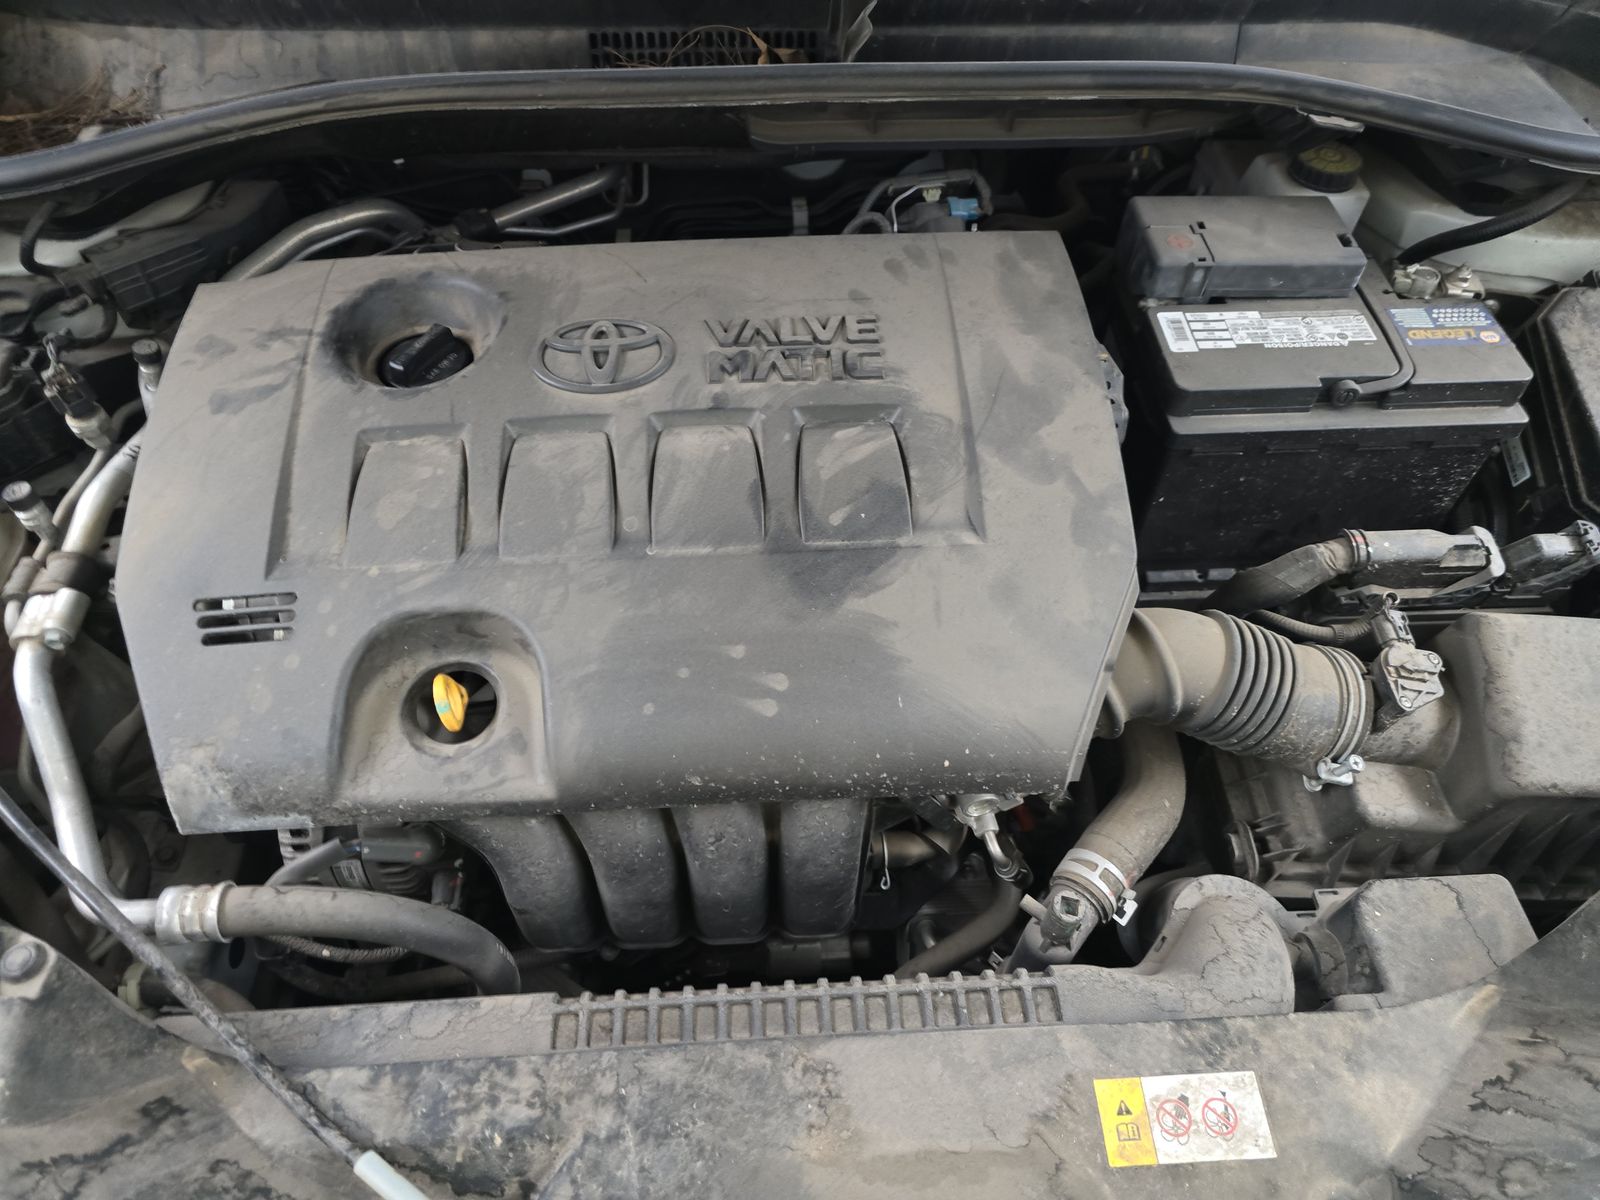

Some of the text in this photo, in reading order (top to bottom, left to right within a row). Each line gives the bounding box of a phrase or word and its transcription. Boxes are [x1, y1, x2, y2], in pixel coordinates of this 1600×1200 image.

[704, 314, 880, 346] VALVE
[1408, 328, 1475, 340] LEGEND
[707, 348, 883, 383] MATIC
